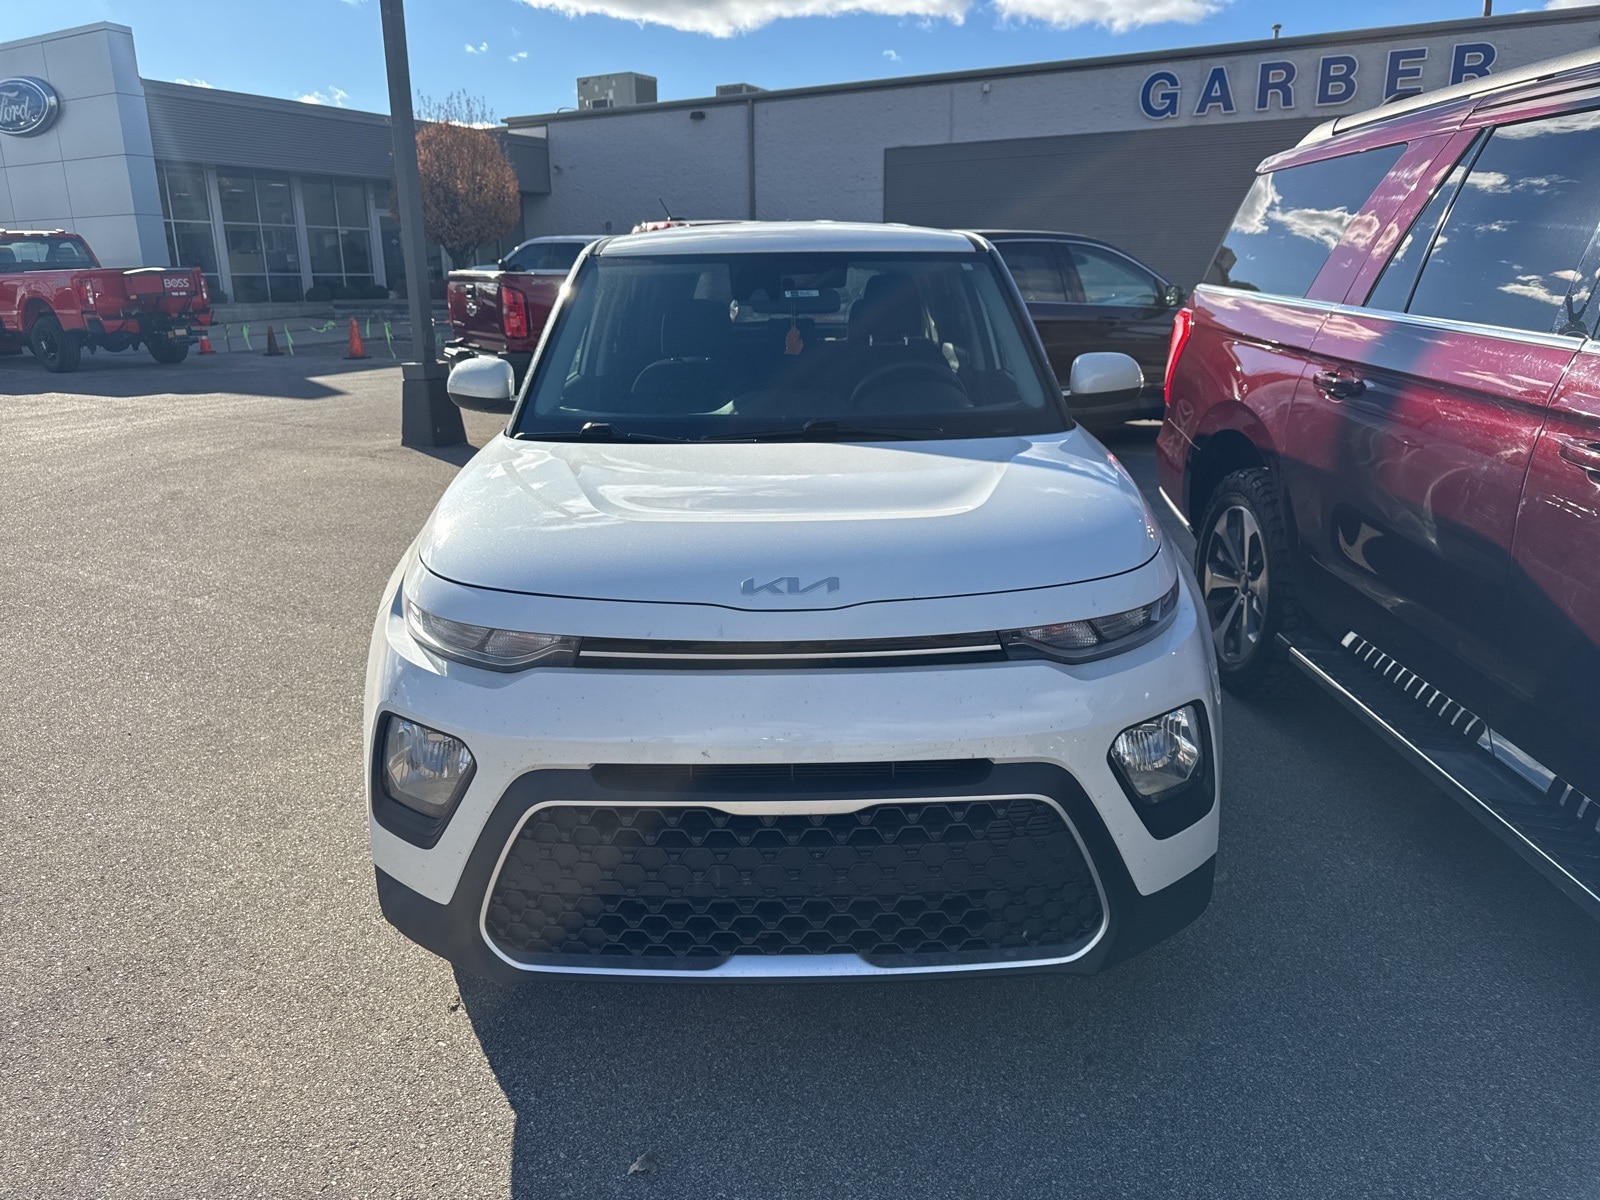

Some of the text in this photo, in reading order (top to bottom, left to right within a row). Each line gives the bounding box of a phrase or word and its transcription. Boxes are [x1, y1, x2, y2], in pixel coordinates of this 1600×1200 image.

[1140, 42, 1498, 119] GARBER
[163, 278, 190, 288] BOSS
[741, 577, 840, 595] KIA
